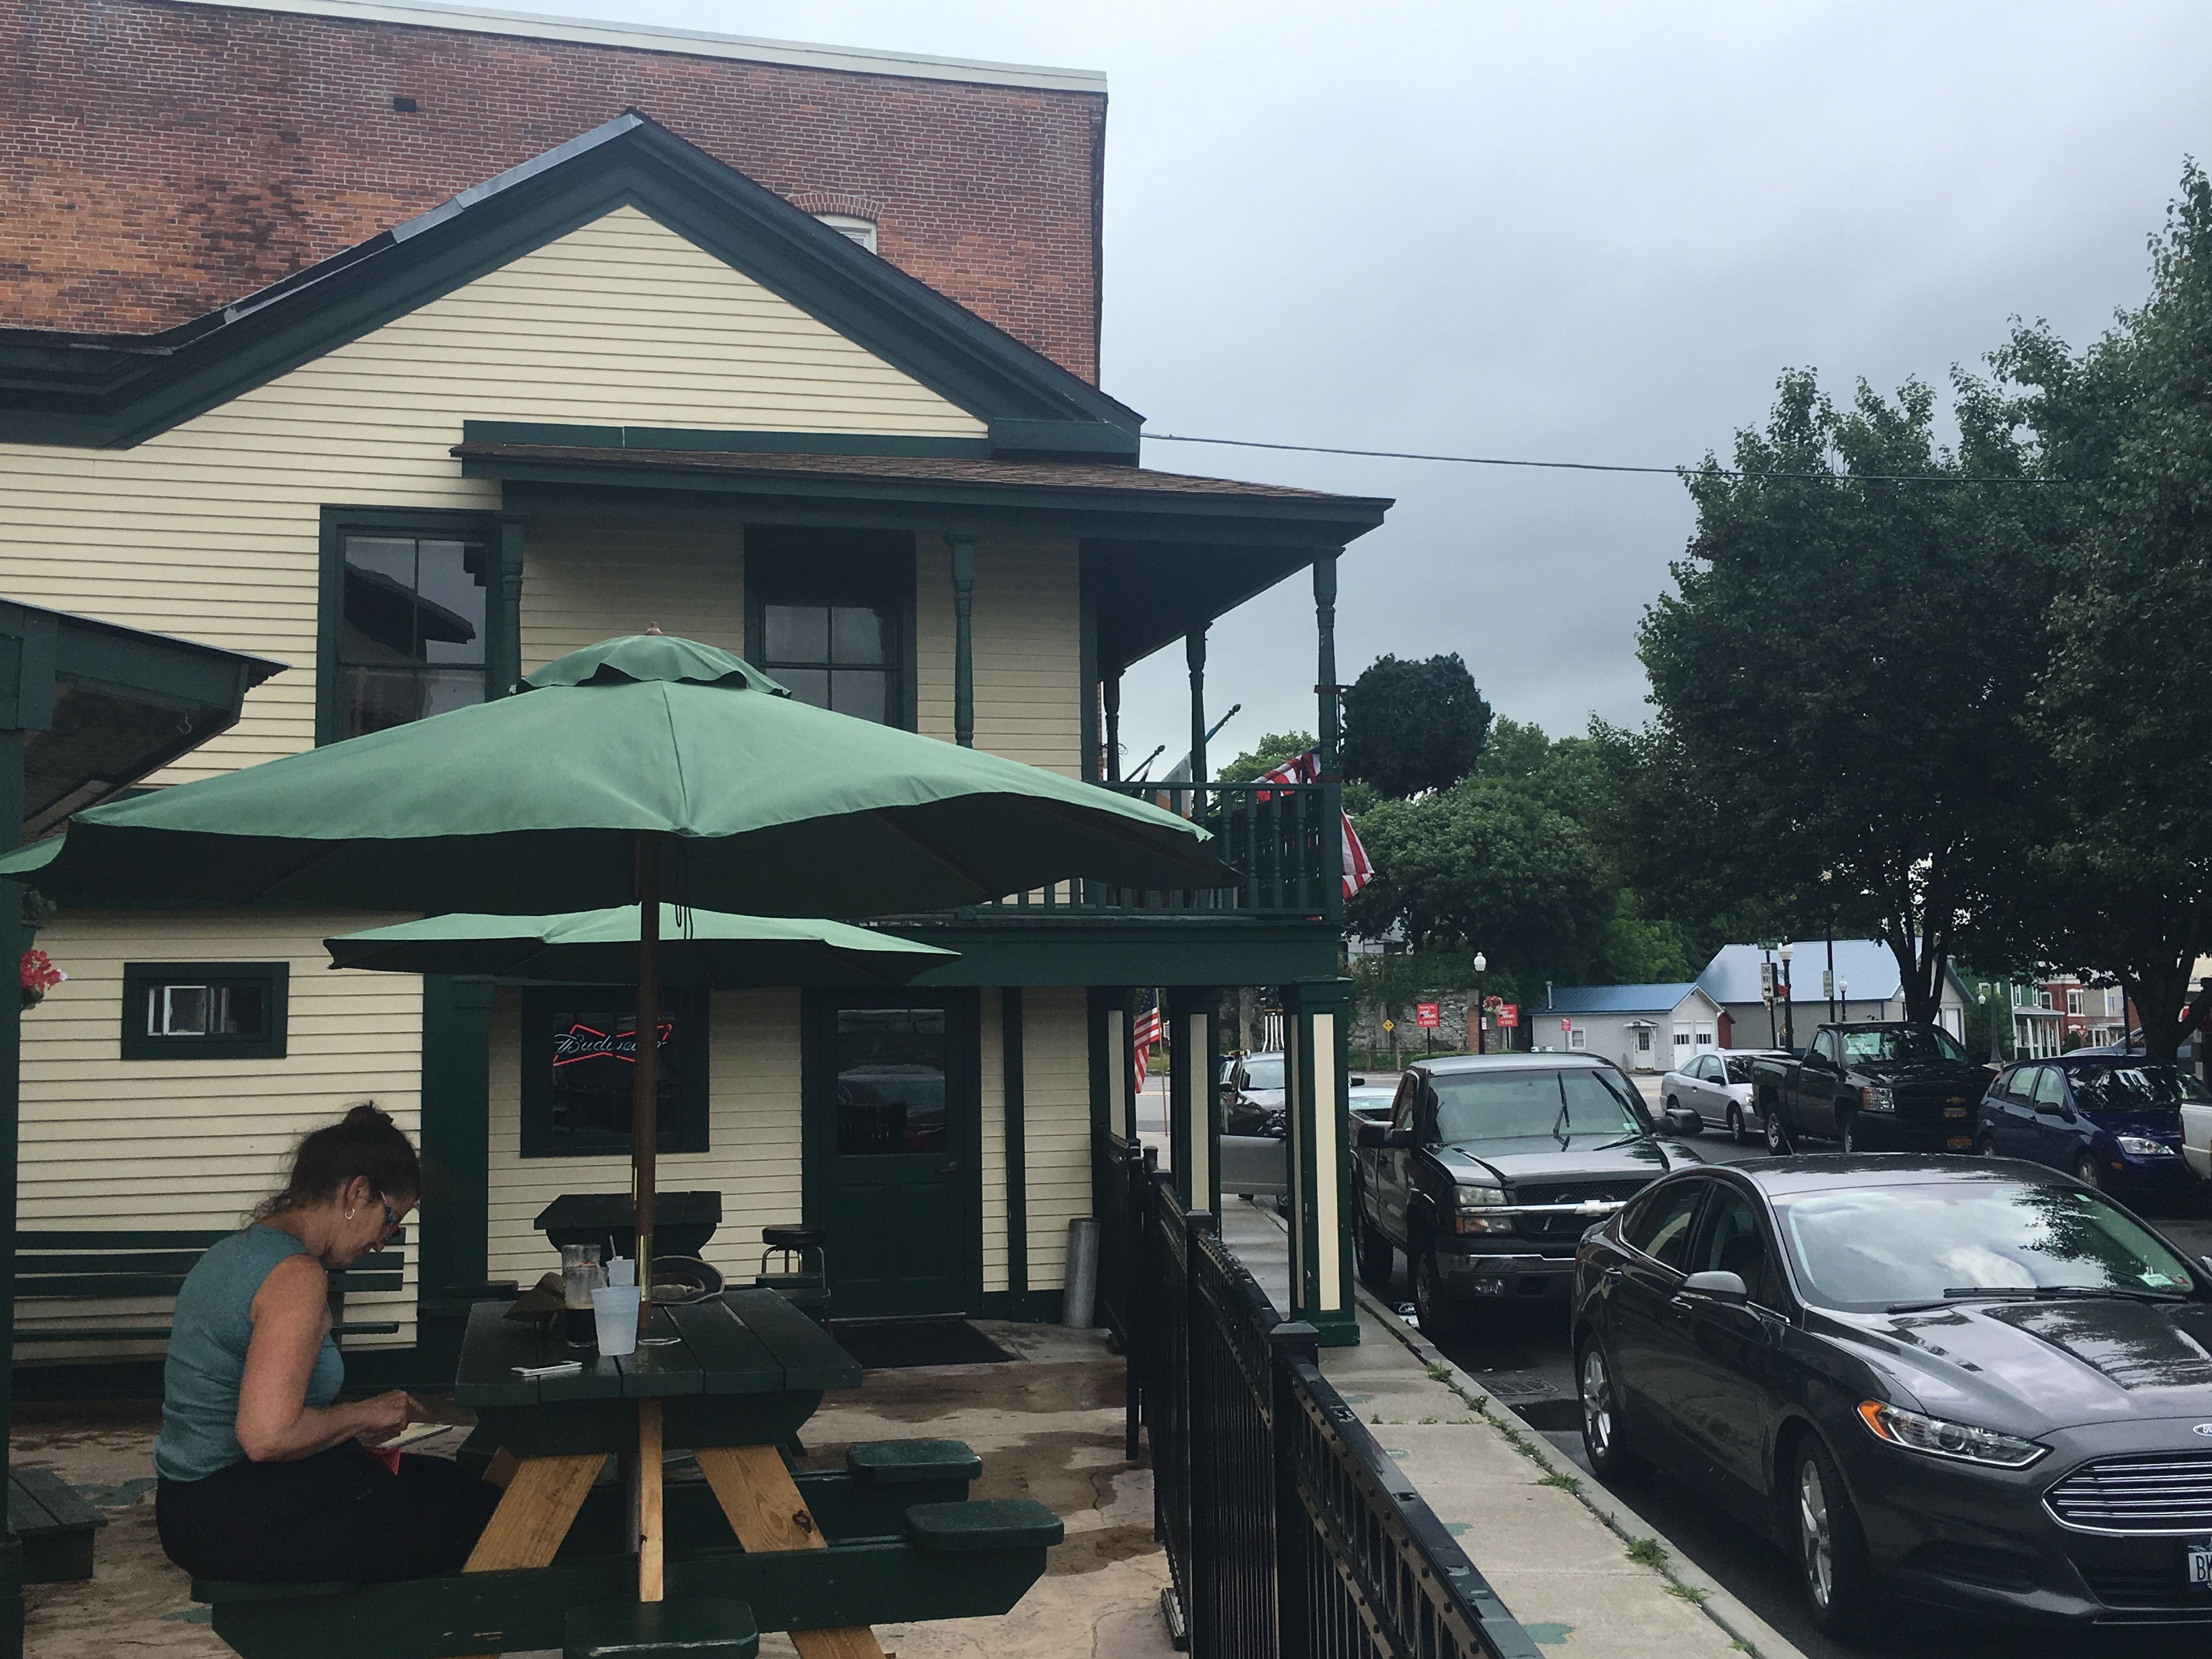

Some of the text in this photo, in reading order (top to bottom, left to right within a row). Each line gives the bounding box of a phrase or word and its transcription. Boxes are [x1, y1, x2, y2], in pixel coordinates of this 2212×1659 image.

[1762, 966, 1771, 974] ONE
[1763, 975, 1771, 984] WAY
[554, 1034, 668, 1054] Budweir
